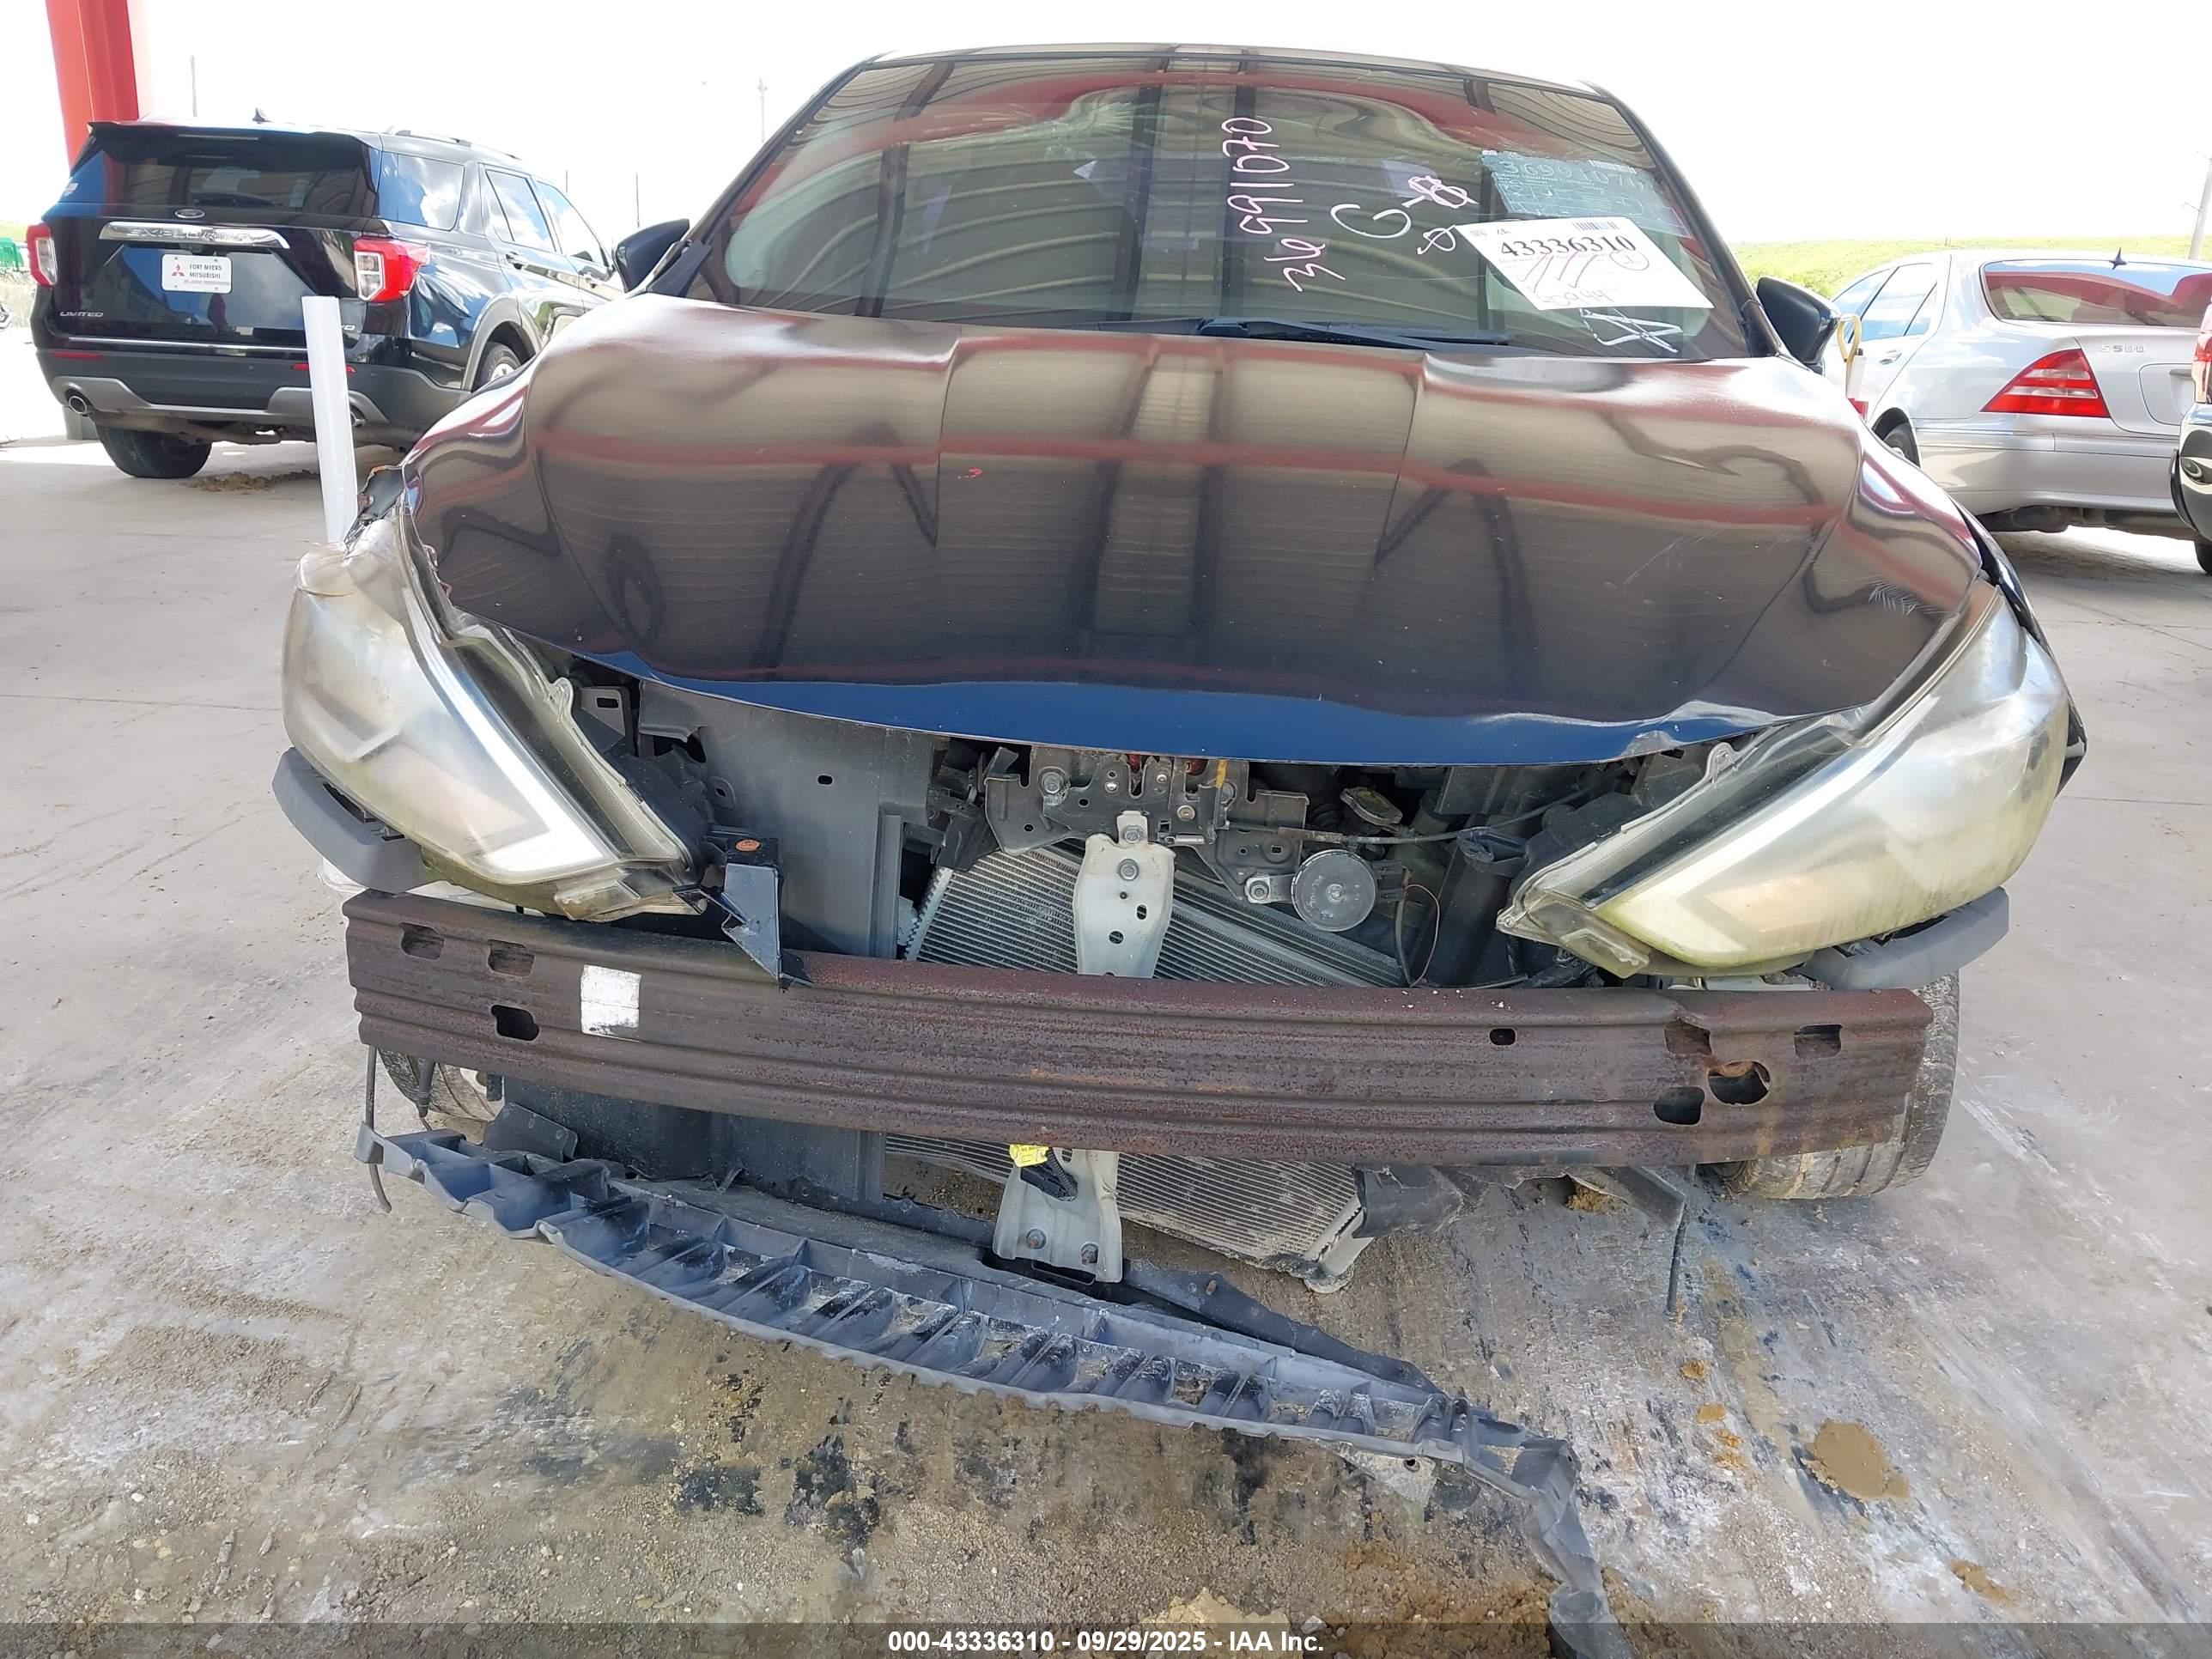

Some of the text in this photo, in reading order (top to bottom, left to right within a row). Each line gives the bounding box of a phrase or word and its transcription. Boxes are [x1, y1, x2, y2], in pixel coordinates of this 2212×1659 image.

[1501, 234, 1637, 257] 43336310
[204, 264, 222, 272] MYERS
[189, 271, 222, 280] MITSUBISHI
